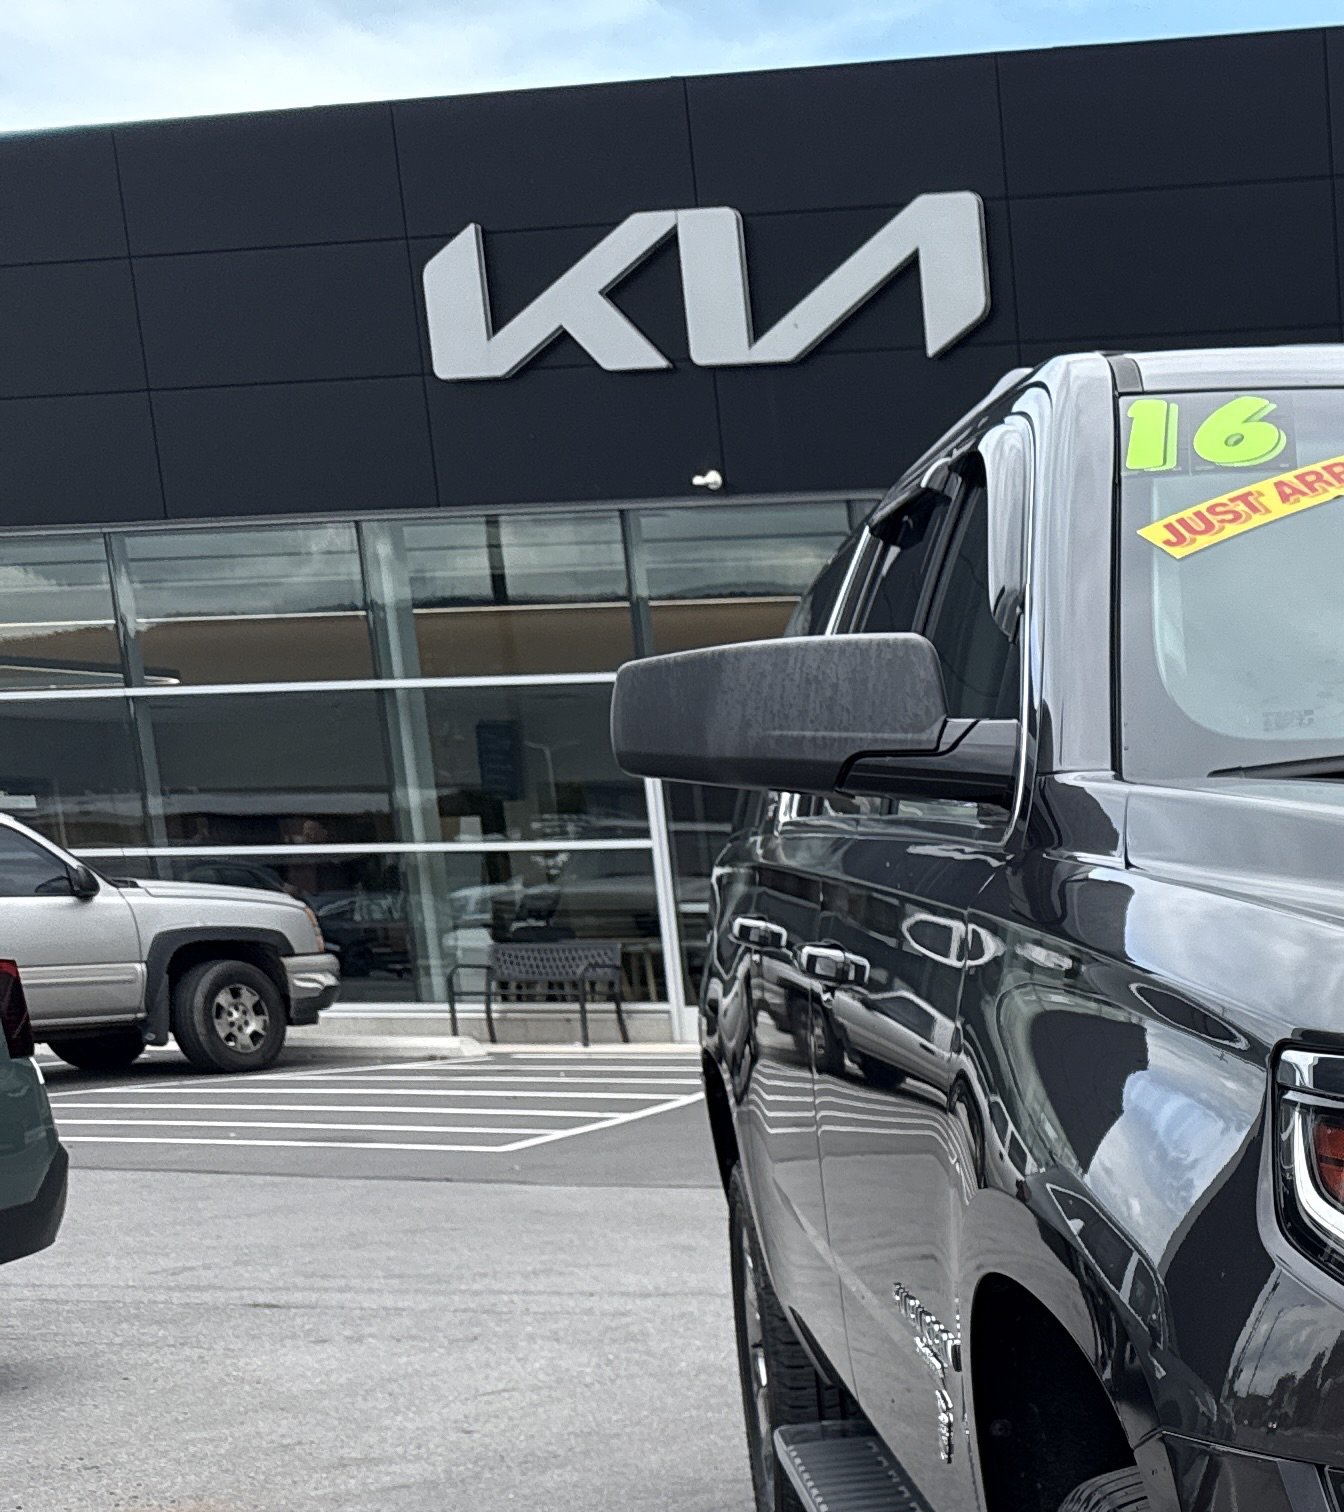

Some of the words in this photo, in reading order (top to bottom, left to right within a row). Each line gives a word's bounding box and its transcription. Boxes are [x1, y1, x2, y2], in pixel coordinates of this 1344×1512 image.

[422, 190, 990, 382] KIA
[1126, 396, 1288, 471] 16
[1162, 490, 1267, 549] JUST
